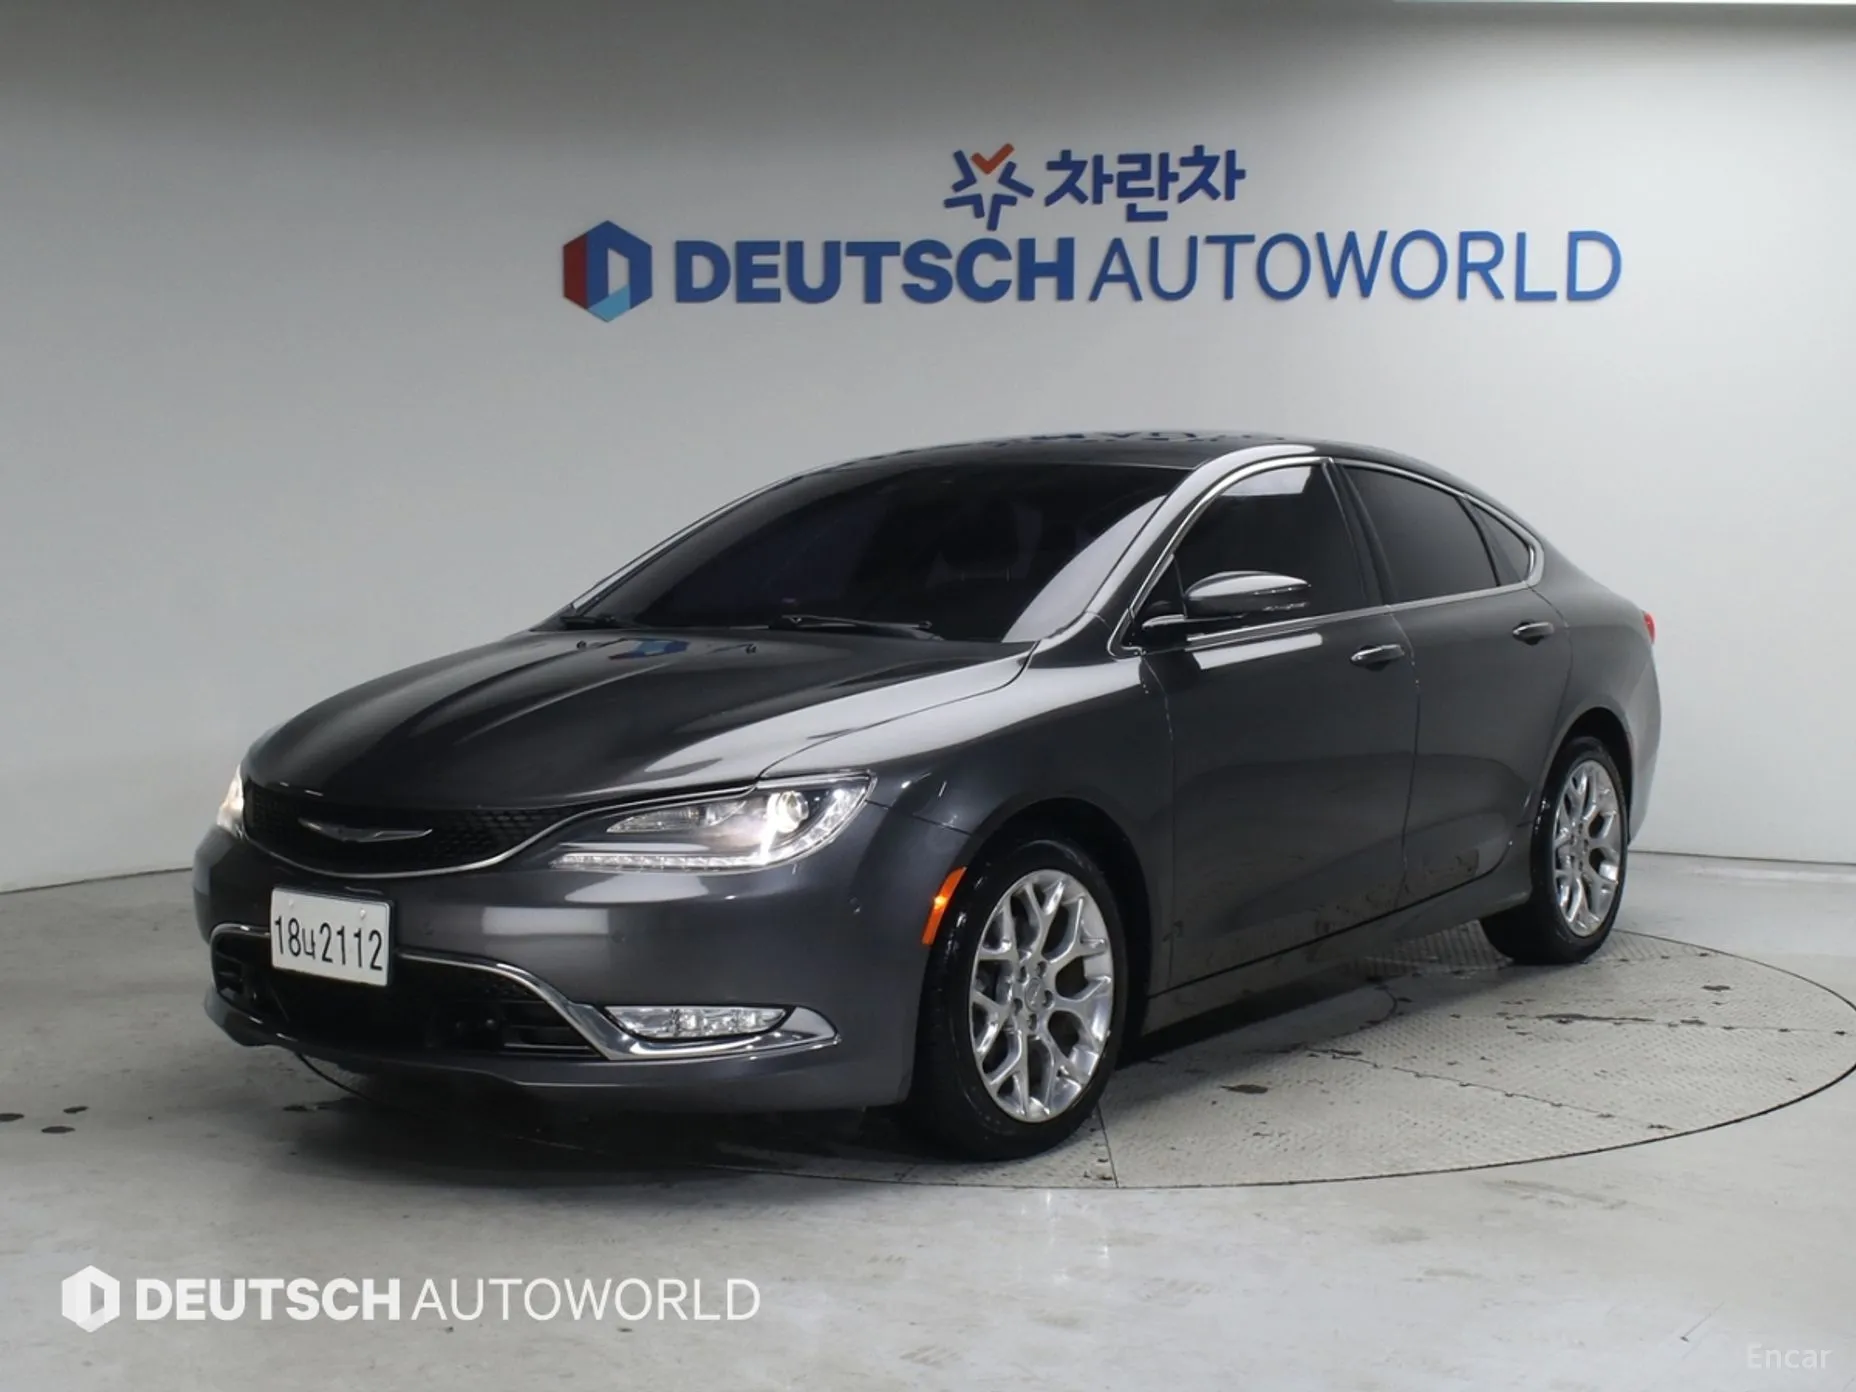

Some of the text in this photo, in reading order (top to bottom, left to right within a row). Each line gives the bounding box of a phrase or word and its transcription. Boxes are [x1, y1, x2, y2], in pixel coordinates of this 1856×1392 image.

[1045, 145, 1246, 222] 차란차
[674, 230, 1622, 304] DEUTSCH AUTOWORLD
